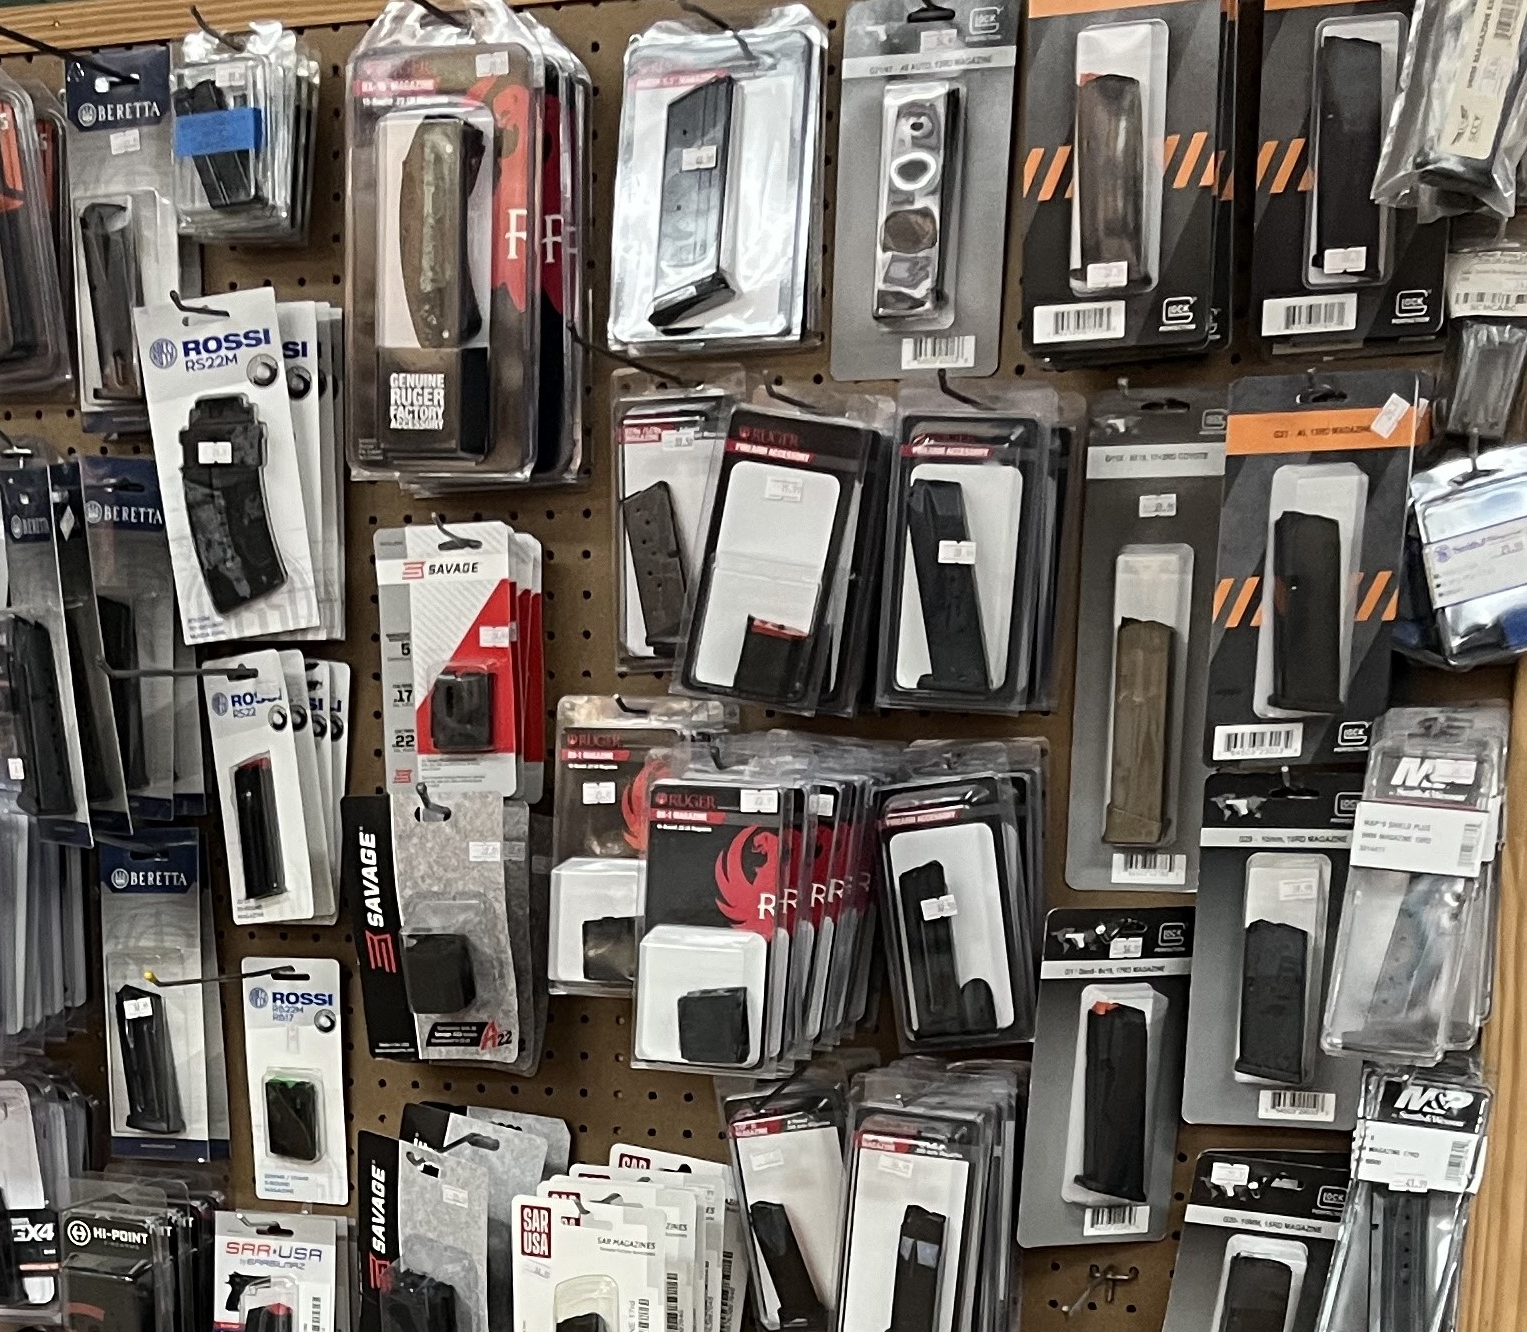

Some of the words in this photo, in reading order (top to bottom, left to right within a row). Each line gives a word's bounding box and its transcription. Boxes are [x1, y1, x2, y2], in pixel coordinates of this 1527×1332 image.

[97, 101, 161, 123] BERETTA
[182, 328, 271, 357] ROSSI
[184, 352, 239, 374] RS22M
[389, 372, 445, 390] GENUINE
[389, 388, 445, 407] RUGER
[389, 405, 445, 422] FACTORY
[389, 418, 445, 431] ACCESSORY
[104, 504, 164, 525] BERETTA
[427, 561, 480, 576] SAVAGE
[668, 795, 717, 809] RUGER
[130, 871, 188, 888] BERETTA
[365, 831, 378, 928] SAVAGE
[271, 991, 334, 1007] ROSSI
[1393, 1085, 1475, 1116] M&P
[370, 1164, 387, 1255] SAVAGE
[522, 1206, 550, 1233] SAR
[11, 1222, 55, 1243] GX4
[93, 1227, 149, 1246] HI-POINT
[523, 1231, 550, 1257] USA
[613, 1238, 656, 1250] MAGAZINES
